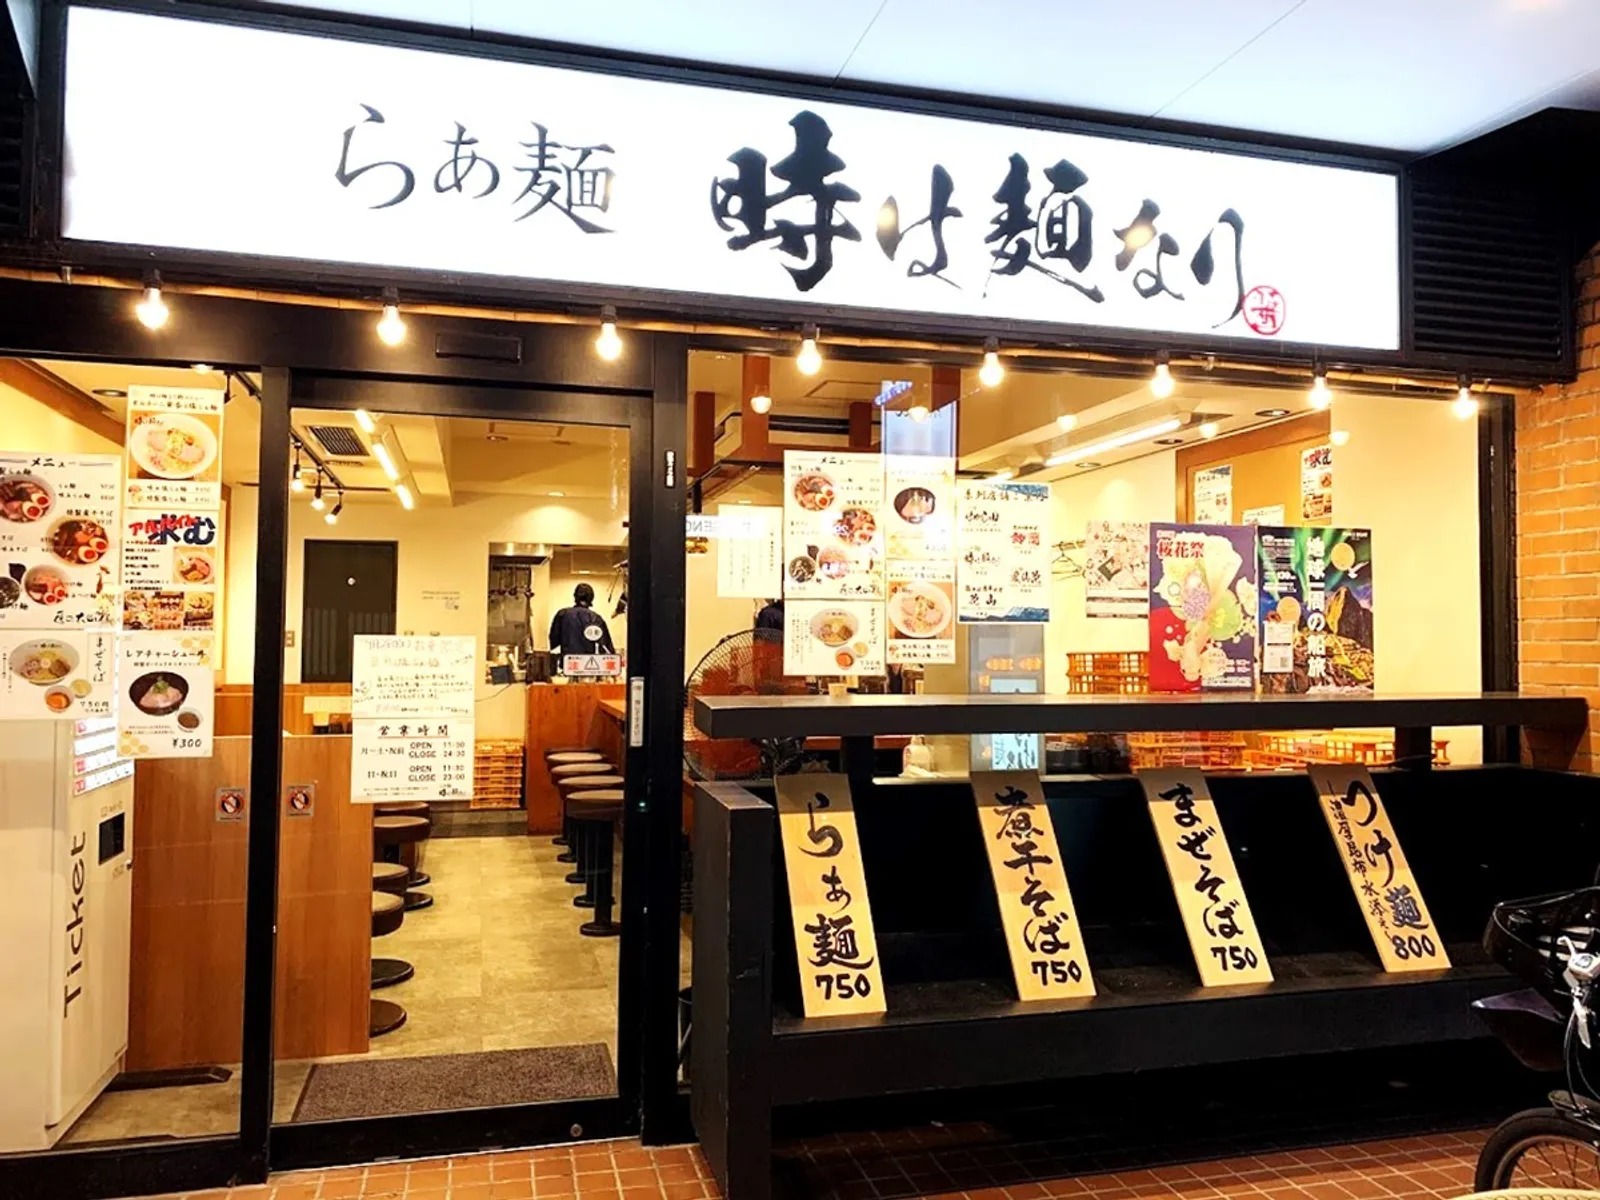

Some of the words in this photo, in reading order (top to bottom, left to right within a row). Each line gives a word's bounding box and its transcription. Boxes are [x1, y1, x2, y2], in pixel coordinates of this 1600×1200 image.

[710, 109, 1244, 329] 時は麺なり
[32, 457, 76, 468] メニュー
[1158, 541, 1205, 559] 桜花祭
[93, 637, 107, 683] まぜそば
[172, 738, 203, 748] ¥300
[378, 724, 449, 736] 営業時間
[408, 774, 436, 782] CLOSE
[443, 773, 465, 781] 23:00
[993, 786, 1070, 954] 煮干そば
[1158, 783, 1244, 939] まぜそば
[1211, 946, 1258, 971] 750
[1342, 780, 1429, 930] つけ麺
[1393, 934, 1436, 960] 800
[64, 831, 86, 1018] Ticket
[815, 973, 871, 1000] 750
[1031, 961, 1082, 986] 750
